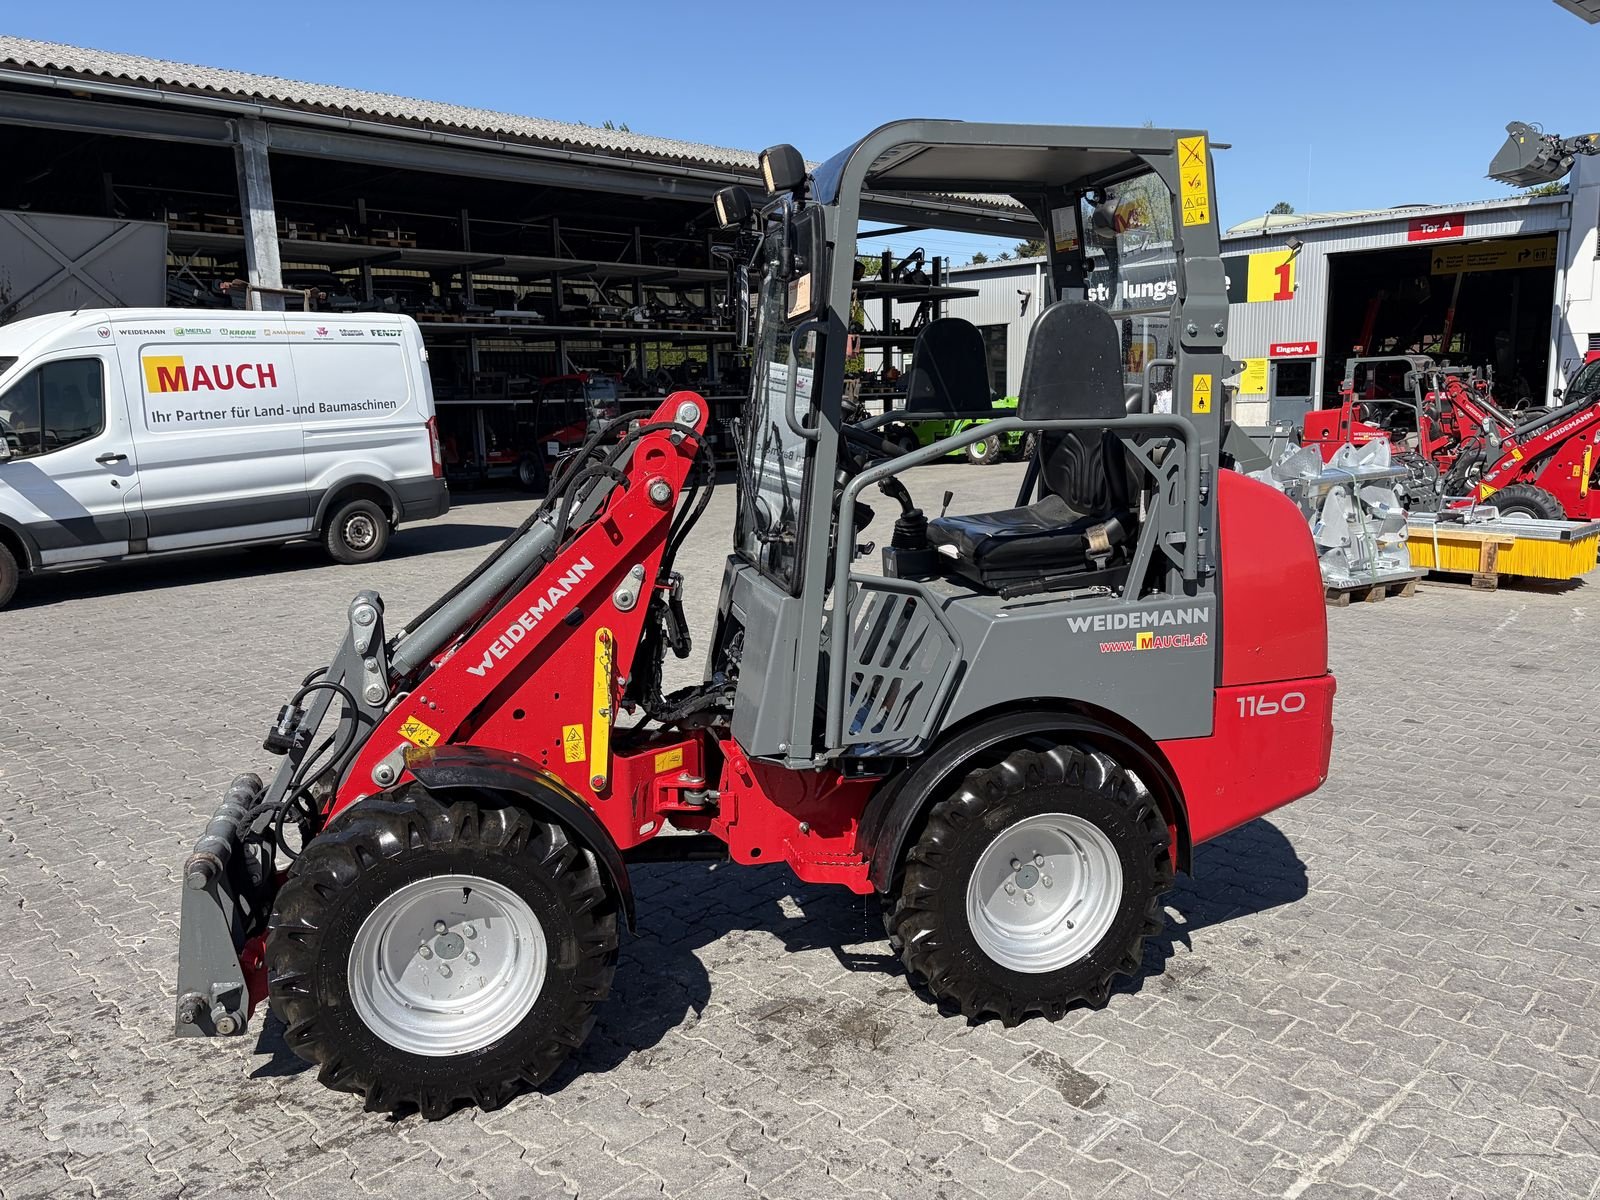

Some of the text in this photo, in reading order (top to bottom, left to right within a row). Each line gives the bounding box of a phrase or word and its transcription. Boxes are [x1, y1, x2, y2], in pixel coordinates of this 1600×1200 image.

[1420, 221, 1452, 233] Tor A
[1273, 263, 1293, 301] 1
[370, 329, 403, 337] FENDT
[1276, 344, 1310, 354] Eingang A
[156, 363, 277, 393] MAUCH
[152, 410, 172, 423] Ihr
[176, 409, 227, 421] Partner
[231, 406, 250, 418] für
[319, 398, 397, 413] Baumaschinen
[1543, 411, 1594, 441] WEIDEMANN
[465, 555, 595, 679] WEIDEMANN
[1066, 606, 1209, 634] WEIDEMANN
[1236, 691, 1306, 718] 1160
